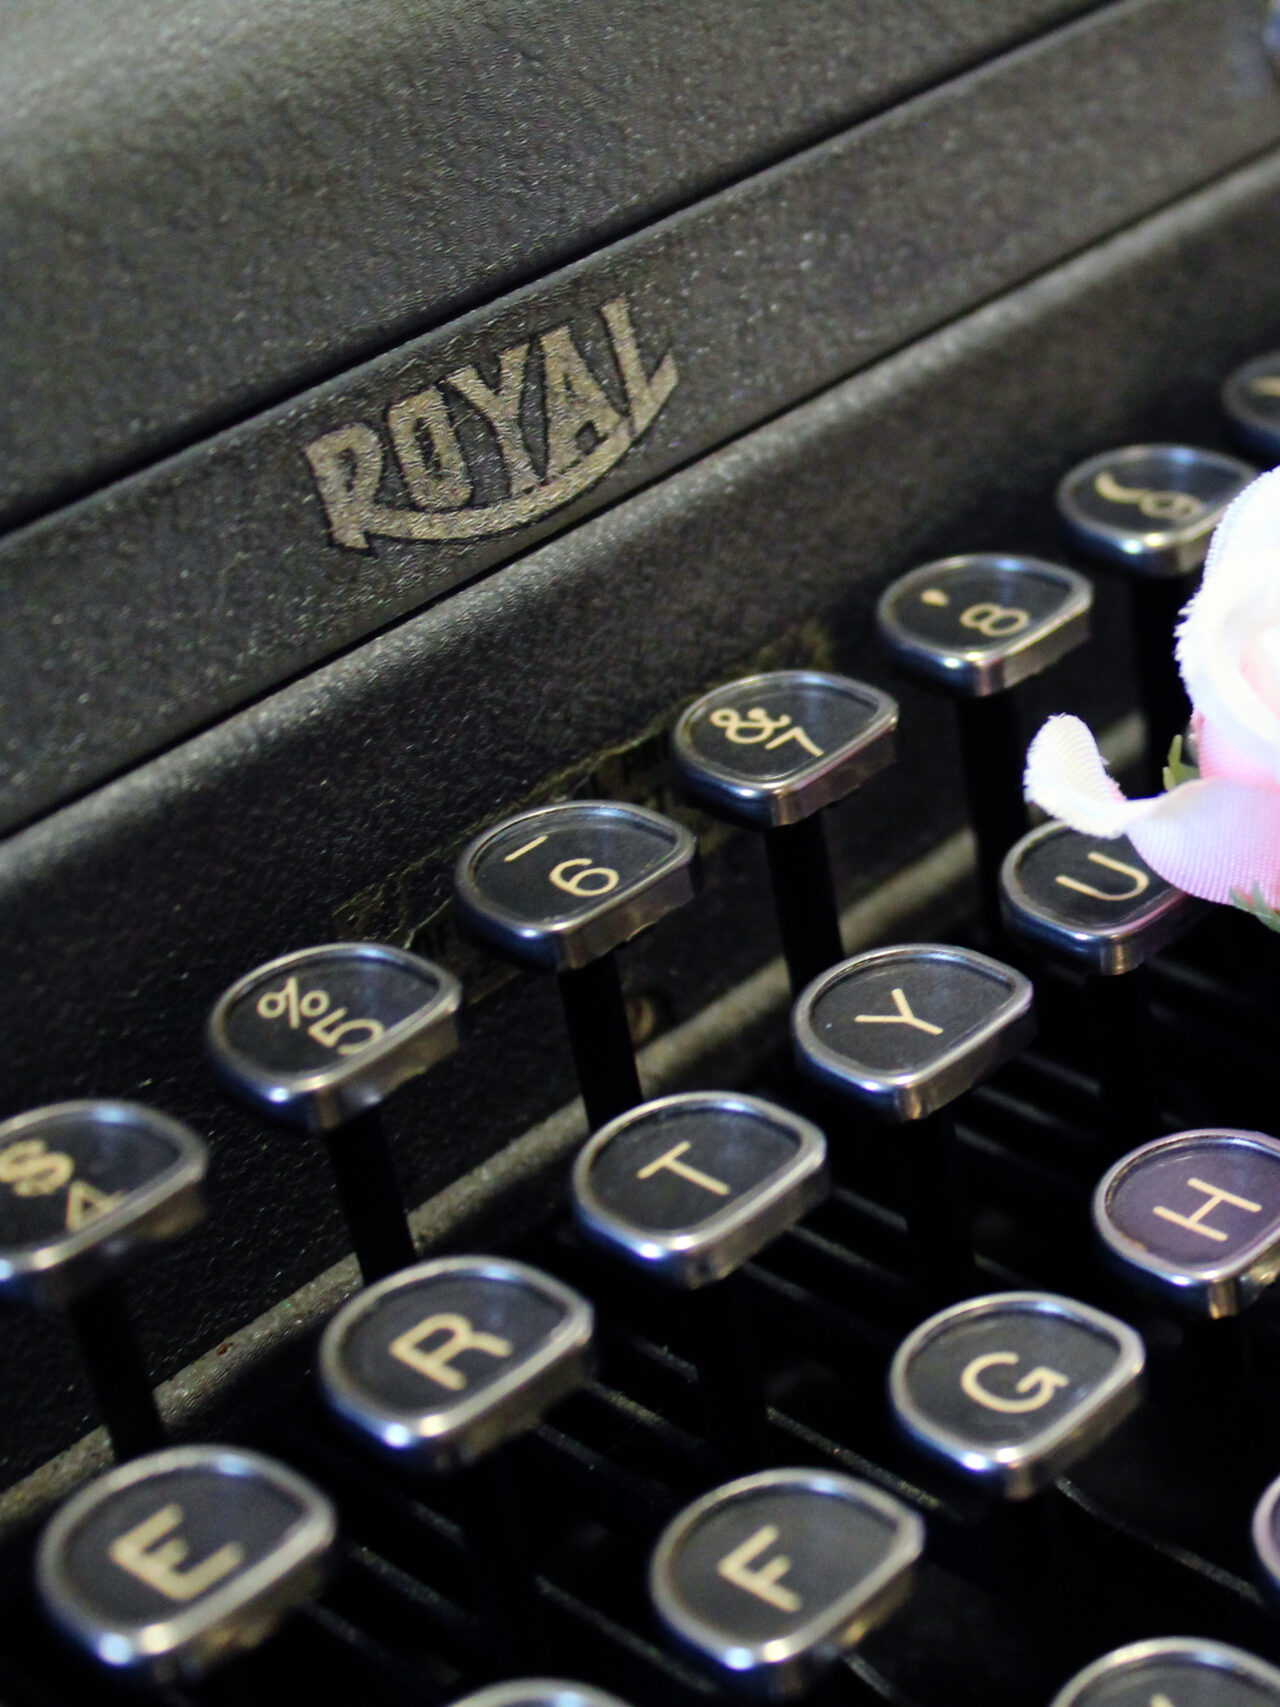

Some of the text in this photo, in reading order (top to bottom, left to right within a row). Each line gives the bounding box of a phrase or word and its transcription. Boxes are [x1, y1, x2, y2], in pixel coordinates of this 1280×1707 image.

[303, 297, 679, 550] ROYAL
[960, 603, 1030, 637] 8
[710, 707, 791, 744] &
[764, 726, 824, 757] 7
[549, 857, 619, 897] 6
[1055, 852, 1149, 901] U
[256, 976, 330, 1029] %
[854, 988, 943, 1036] Y
[308, 1007, 385, 1055] 5
[637, 1141, 729, 1196] T
[1152, 1177, 1262, 1242] H
[389, 1313, 512, 1391] R
[960, 1351, 1069, 1414] G
[110, 1504, 243, 1601] E
[717, 1524, 800, 1612] F
